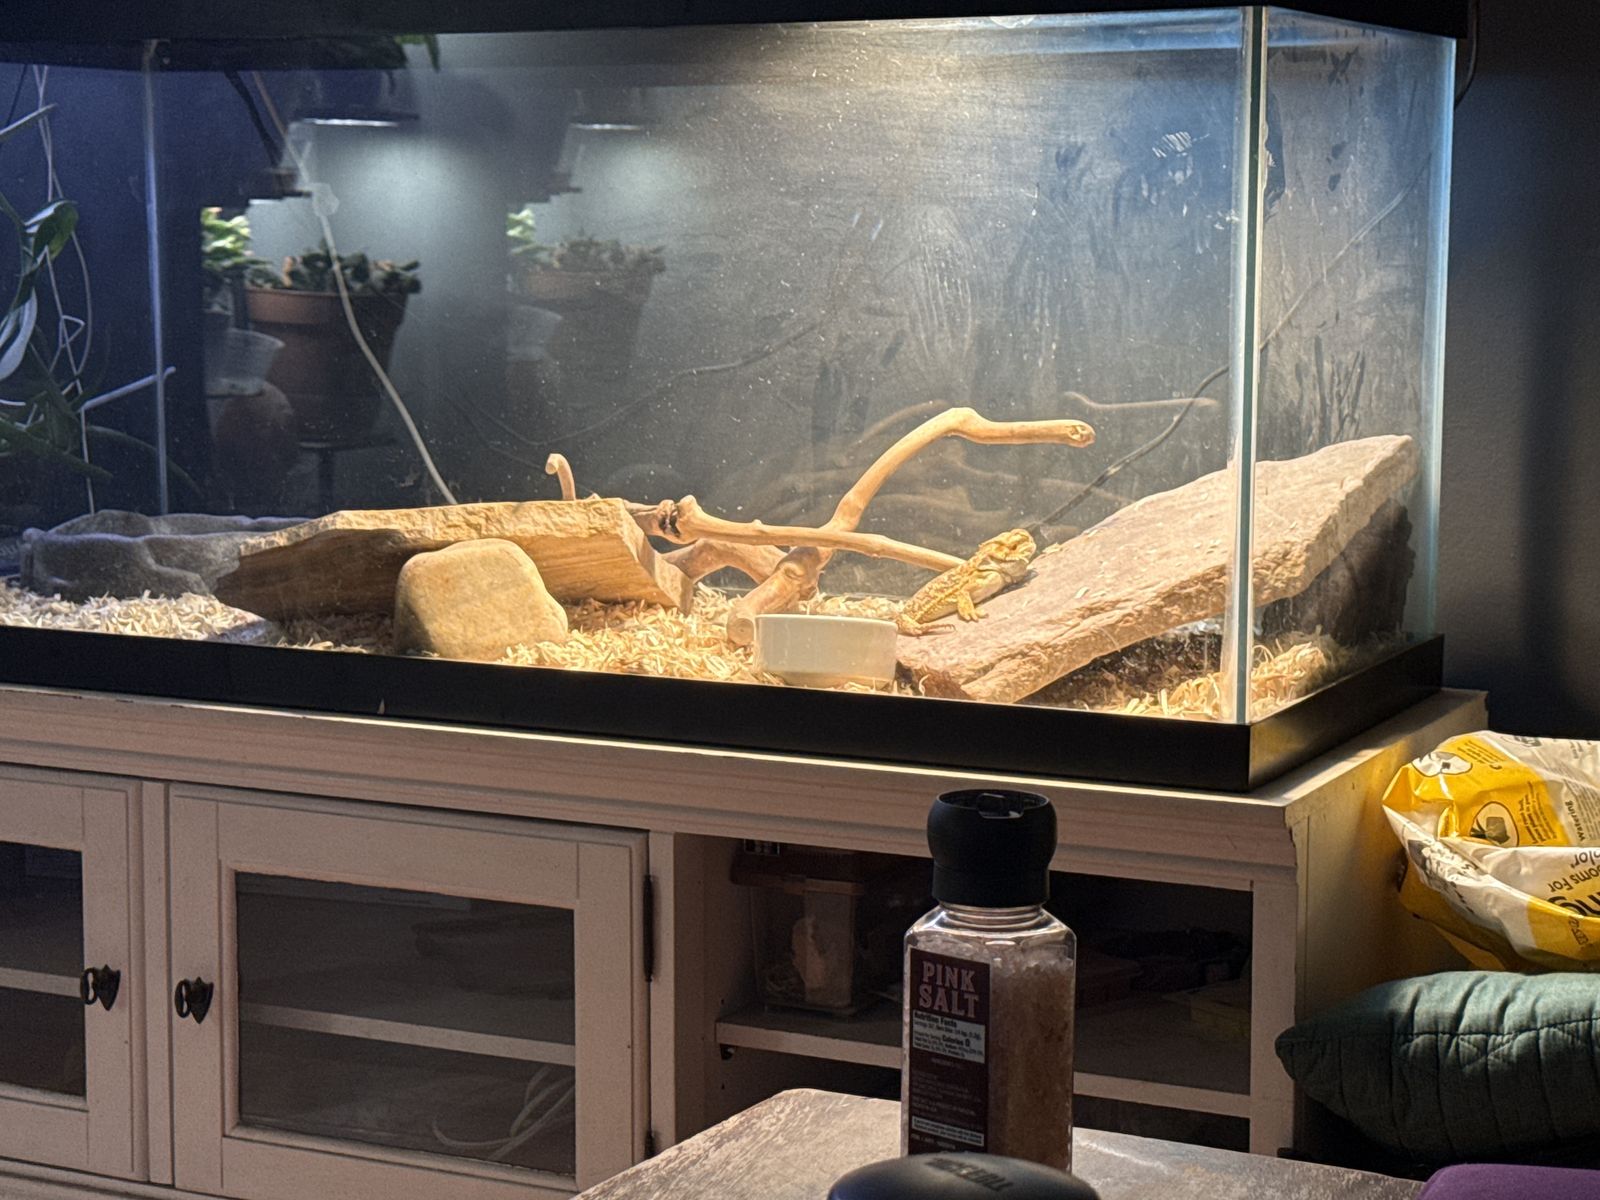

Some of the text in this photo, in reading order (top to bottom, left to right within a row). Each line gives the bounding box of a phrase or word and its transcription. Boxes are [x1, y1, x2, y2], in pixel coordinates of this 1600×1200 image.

[1565, 800, 1586, 841] Watering
[1547, 878, 1574, 893] For
[922, 960, 976, 993] PINK
[918, 983, 980, 1018] SALT
